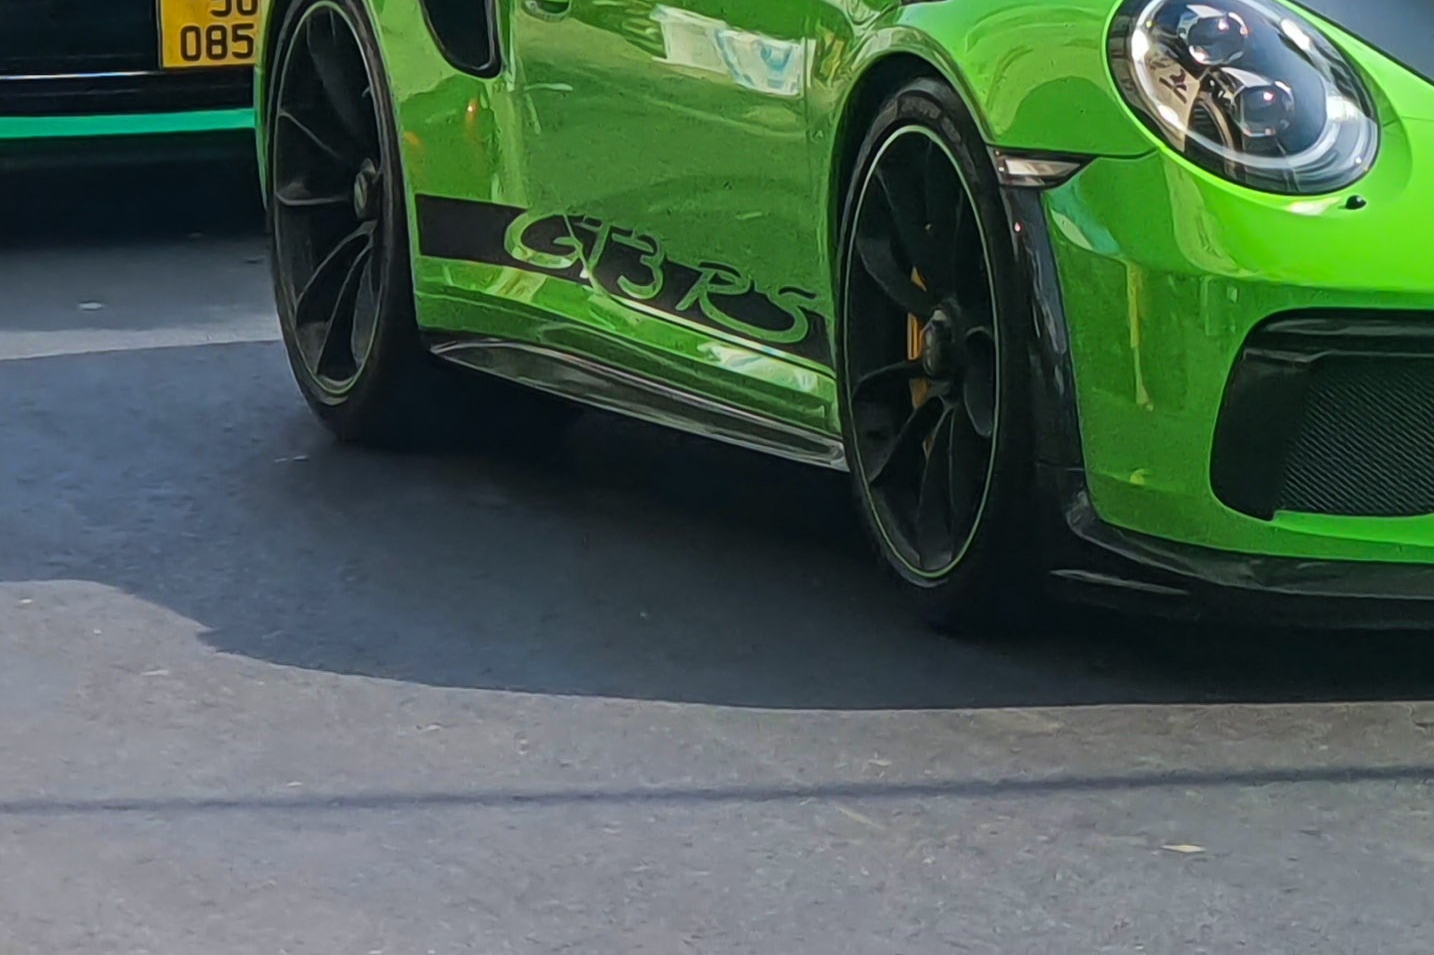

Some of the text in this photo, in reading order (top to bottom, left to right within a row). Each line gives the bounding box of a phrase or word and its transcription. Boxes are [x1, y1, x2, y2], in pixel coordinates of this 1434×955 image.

[180, 23, 255, 62] 085
[504, 209, 820, 344] GT3 RS
